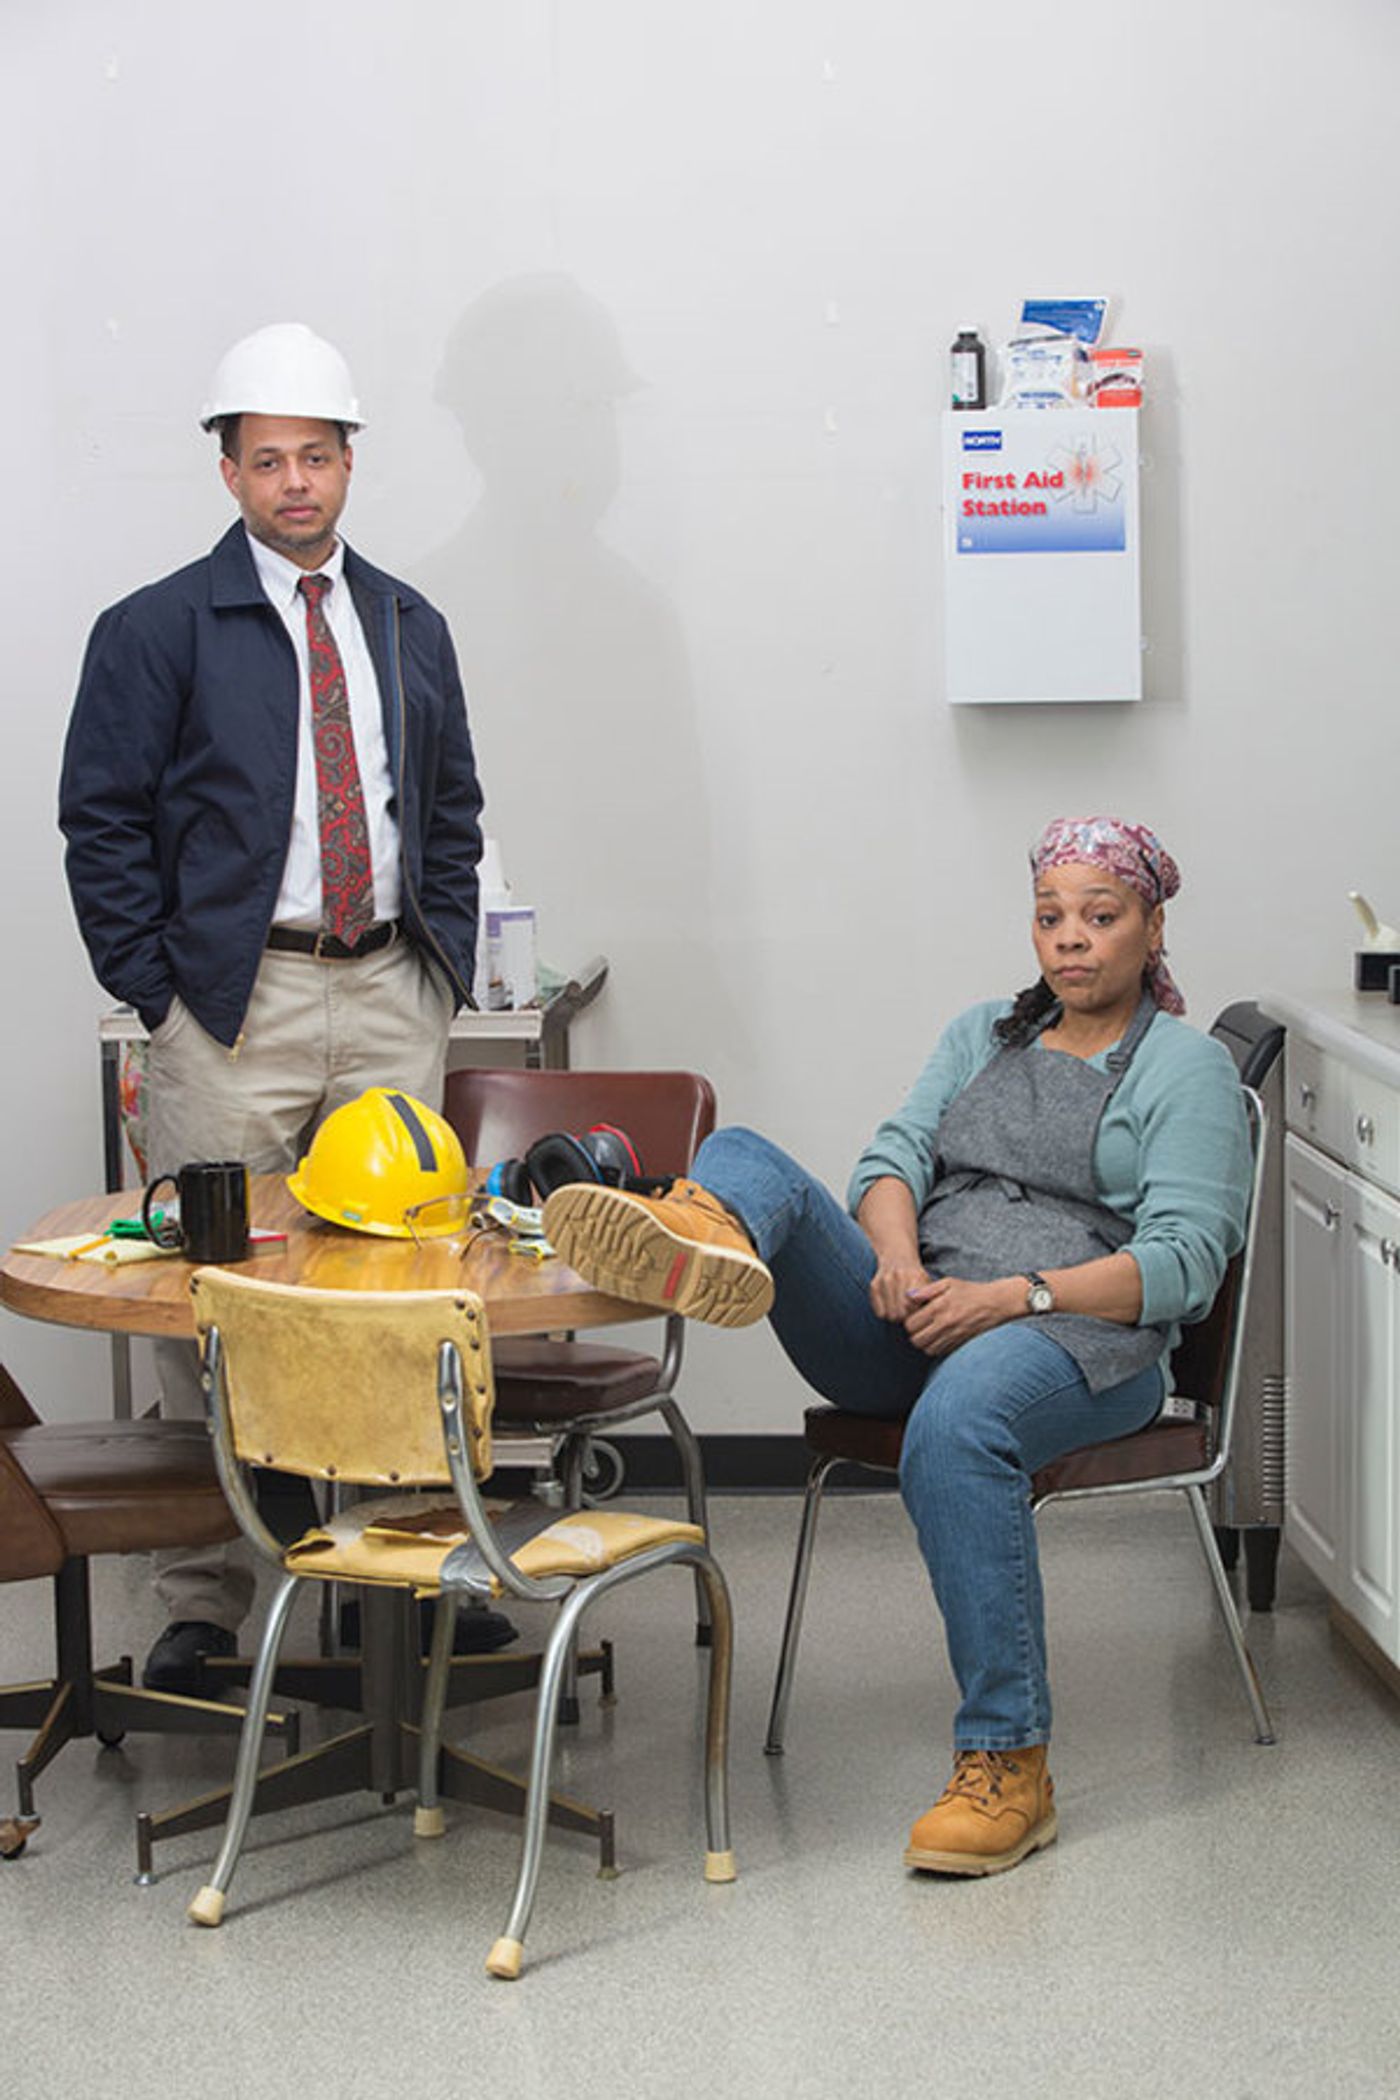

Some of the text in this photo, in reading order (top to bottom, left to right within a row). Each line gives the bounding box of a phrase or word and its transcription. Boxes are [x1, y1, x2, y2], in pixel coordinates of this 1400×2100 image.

[962, 471, 1064, 489] First Aid
[962, 498, 1047, 516] Station
